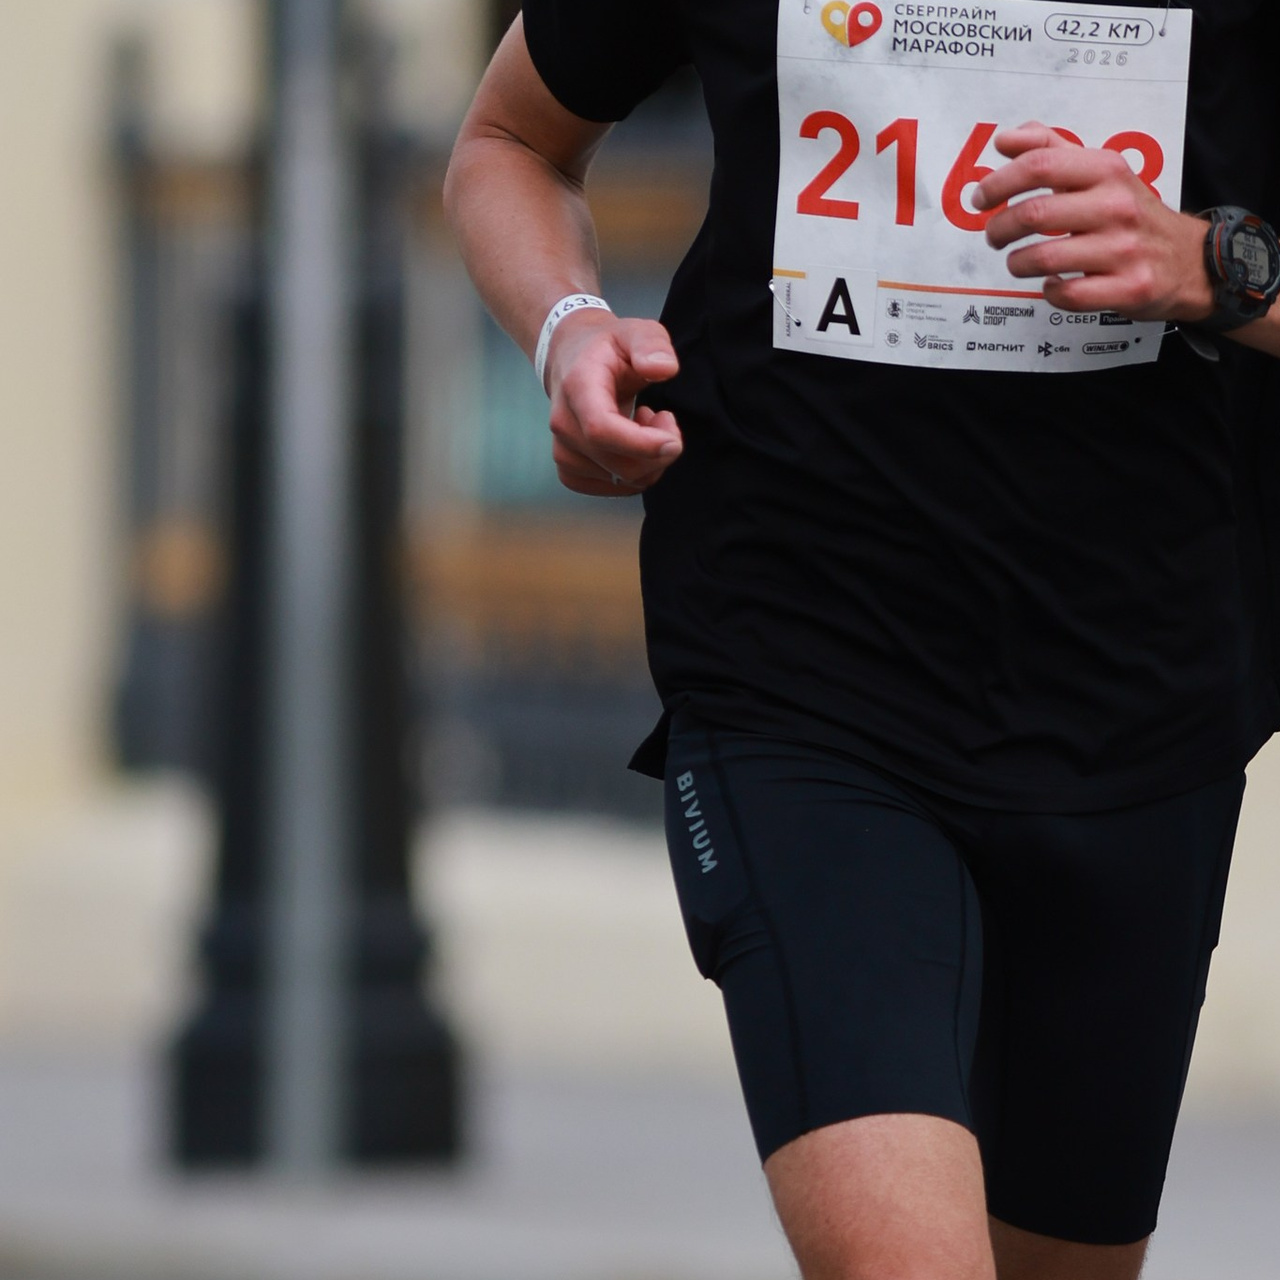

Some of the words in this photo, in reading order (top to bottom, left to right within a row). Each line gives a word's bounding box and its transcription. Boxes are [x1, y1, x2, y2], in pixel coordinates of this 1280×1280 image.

[894, 3, 997, 21] СБЕРПРАЙМ
[893, 19, 1032, 42] МОСКОВСКИЙ
[1056, 19, 1100, 38] 42,2
[1108, 23, 1140, 39] КМ
[892, 37, 995, 57] МАРАФОН
[797, 110, 1165, 237] 216
[983, 305, 1034, 318] МОСКОВСКИЙ
[983, 316, 1007, 326] СПОРТ
[1066, 315, 1097, 324] СБЕР
[927, 342, 954, 351] BRICS
[978, 342, 1025, 353] магнит
[1086, 344, 1119, 352] WINLINE
[676, 769, 718, 874] BIVIUM
